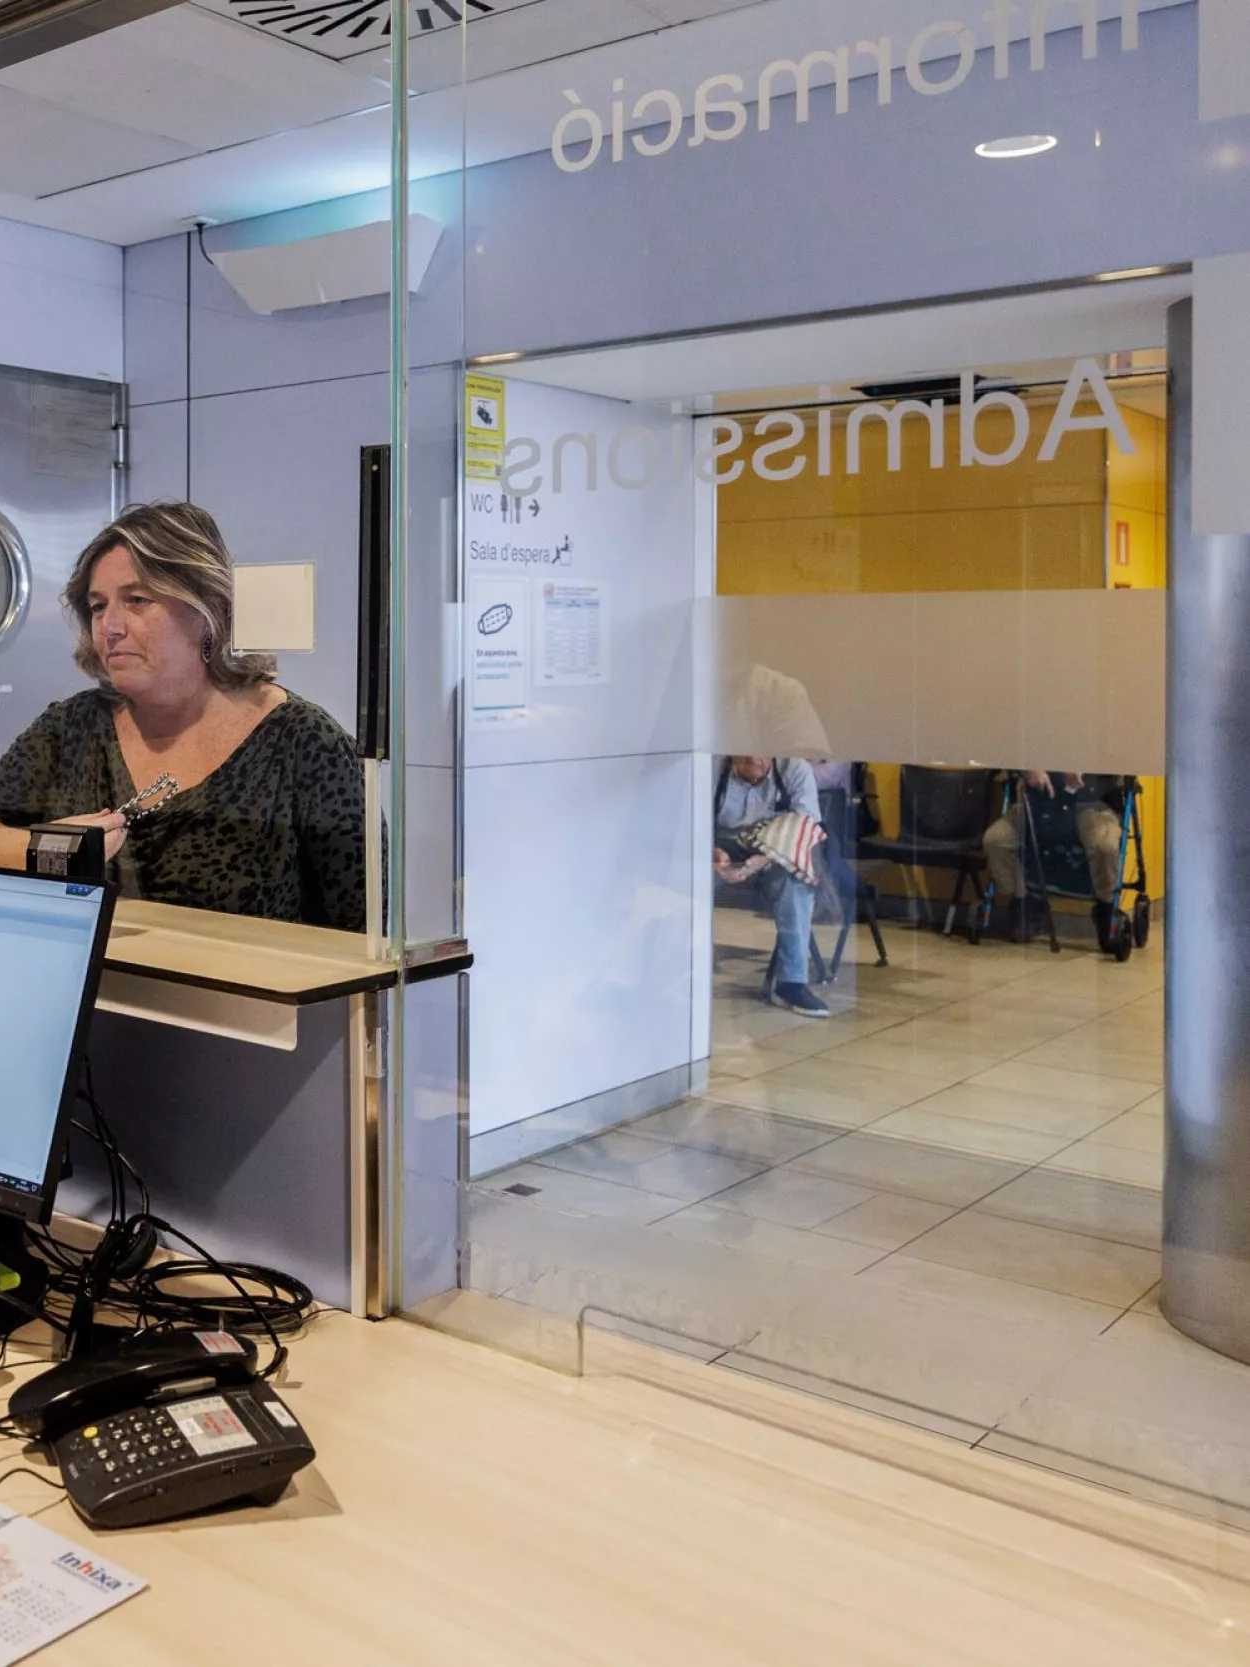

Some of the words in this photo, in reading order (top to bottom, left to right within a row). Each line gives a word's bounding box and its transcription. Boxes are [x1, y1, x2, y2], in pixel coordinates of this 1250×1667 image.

[470, 493, 494, 514] WC
[470, 540, 497, 561] Sala
[500, 542, 551, 568] d'espera
[58, 1551, 122, 1590] Inhixa
